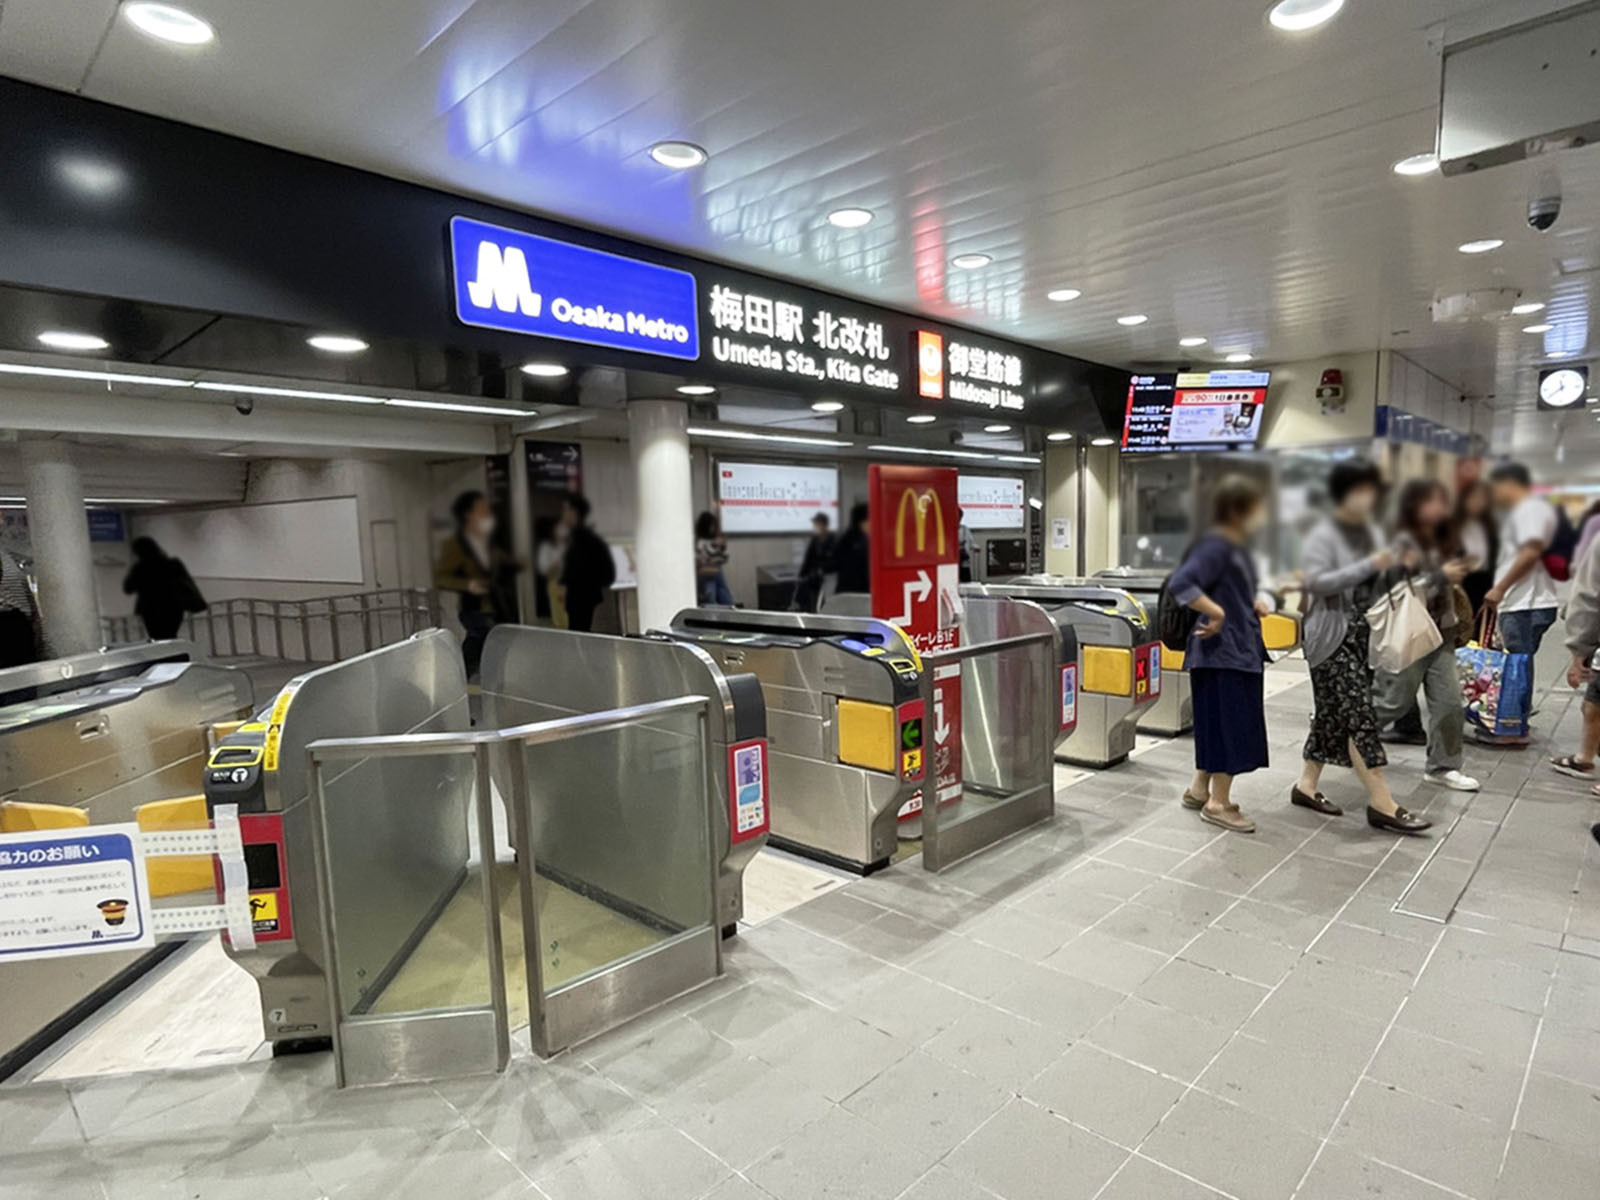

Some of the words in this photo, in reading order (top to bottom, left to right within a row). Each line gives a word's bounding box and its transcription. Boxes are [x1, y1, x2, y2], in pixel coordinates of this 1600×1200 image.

[551, 297, 625, 333] Osaka
[627, 311, 689, 344] Metro
[710, 284, 805, 344] 梅田駅
[812, 310, 890, 361] 北改札
[712, 336, 783, 371] Umeda
[826, 357, 862, 384] Kita
[862, 364, 899, 390] Gate
